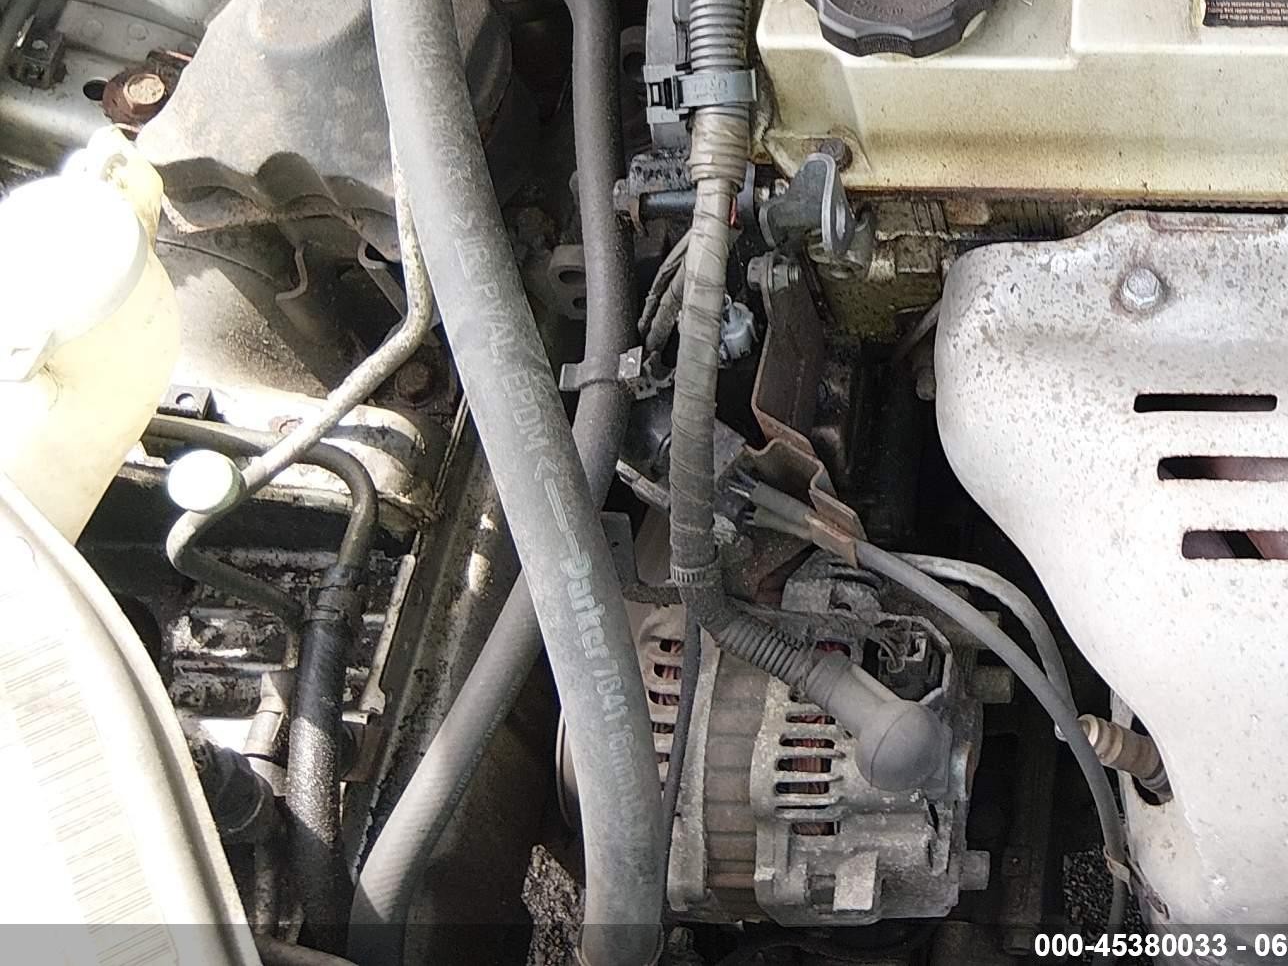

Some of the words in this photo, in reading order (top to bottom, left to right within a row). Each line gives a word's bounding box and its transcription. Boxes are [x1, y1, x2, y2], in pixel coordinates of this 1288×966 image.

[502, 368, 551, 453] EPDM
[559, 550, 610, 660] Parker
[592, 657, 630, 723] 7641
